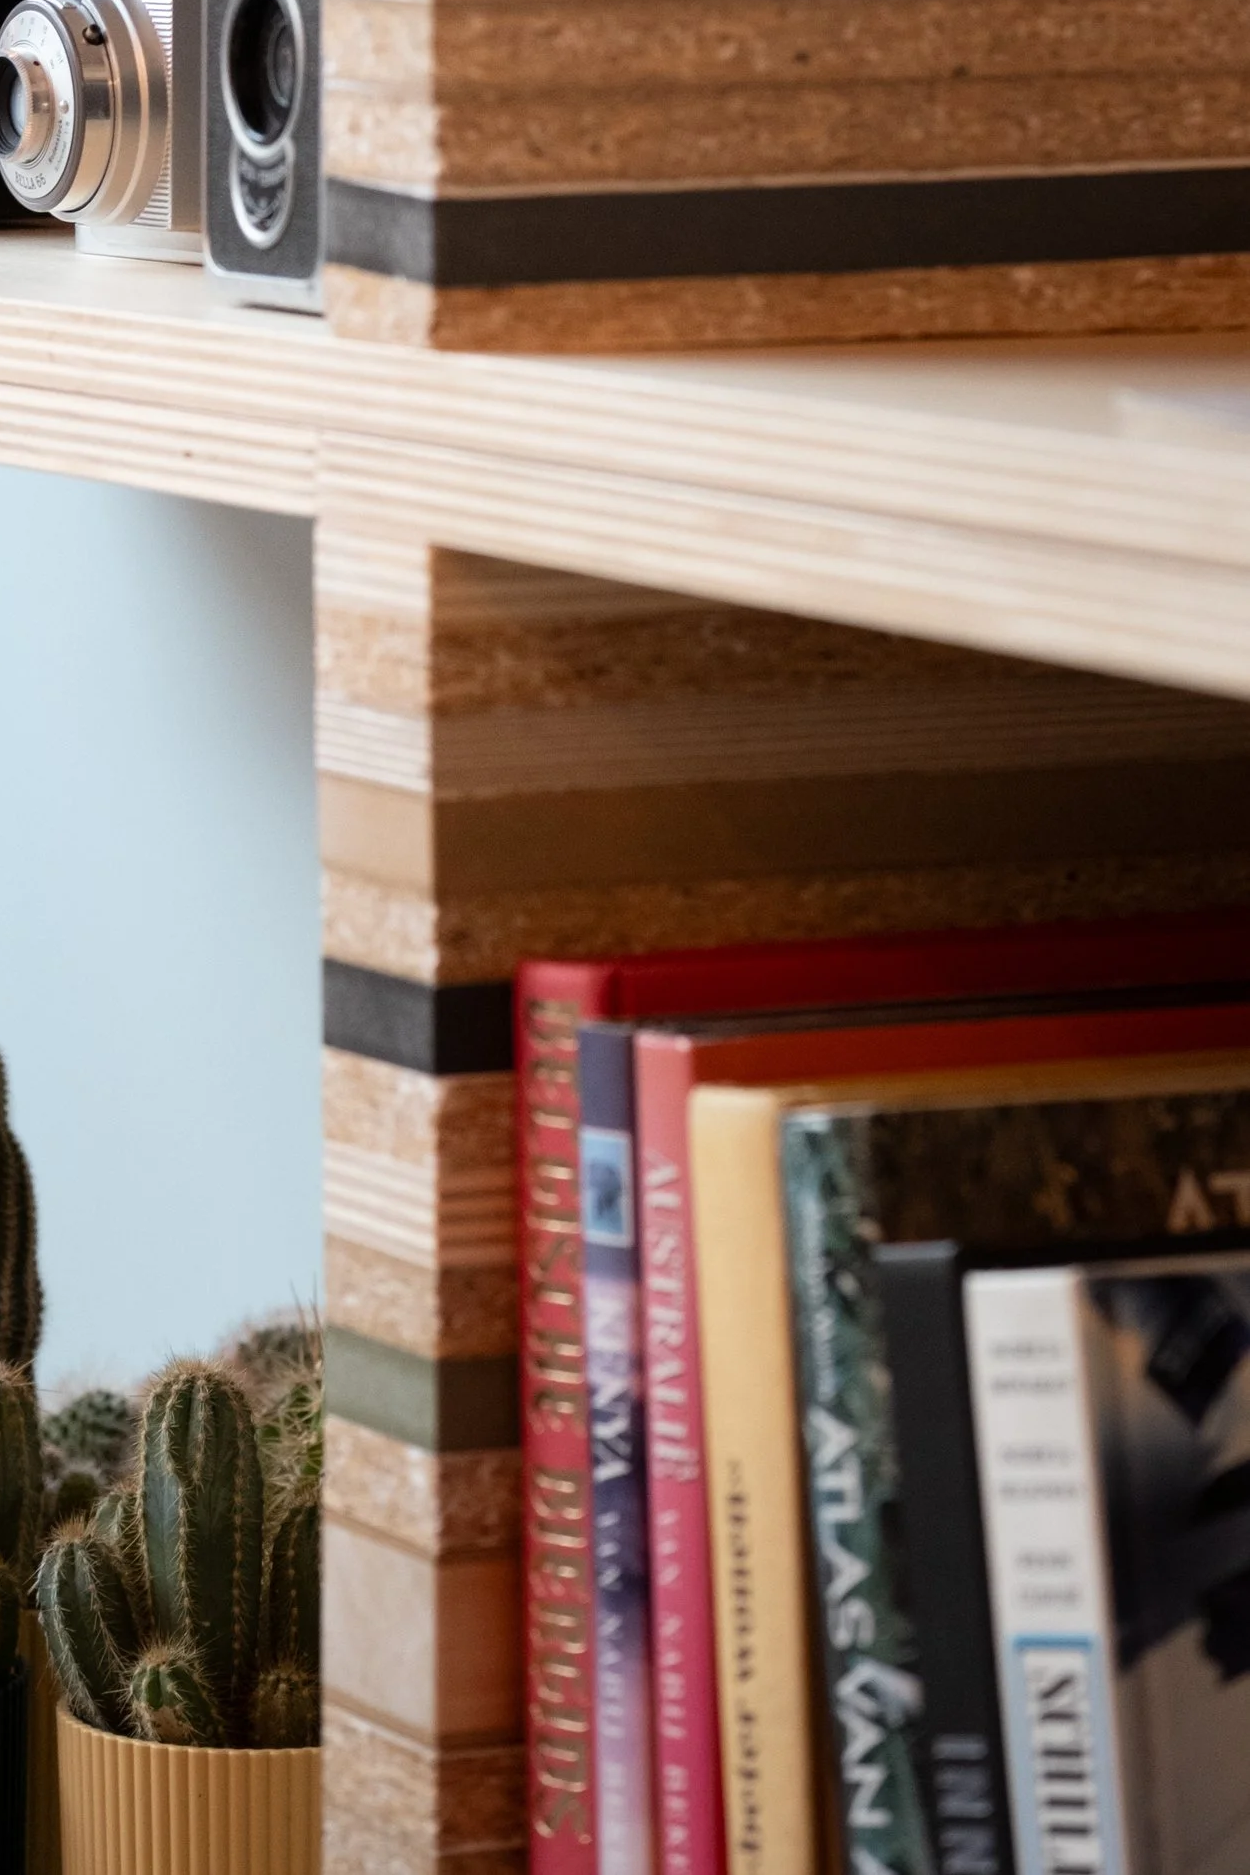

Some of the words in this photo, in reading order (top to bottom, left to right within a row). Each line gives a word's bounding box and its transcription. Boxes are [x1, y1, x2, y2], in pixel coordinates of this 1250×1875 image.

[14, 171, 37, 190] BELLA
[34, 172, 47, 188] 66
[586, 1295, 633, 1483] KENYA
[808, 1405, 876, 1649] ATLAS
[528, 1466, 594, 1845] BIERGIDS
[836, 1667, 893, 1827] VAN
